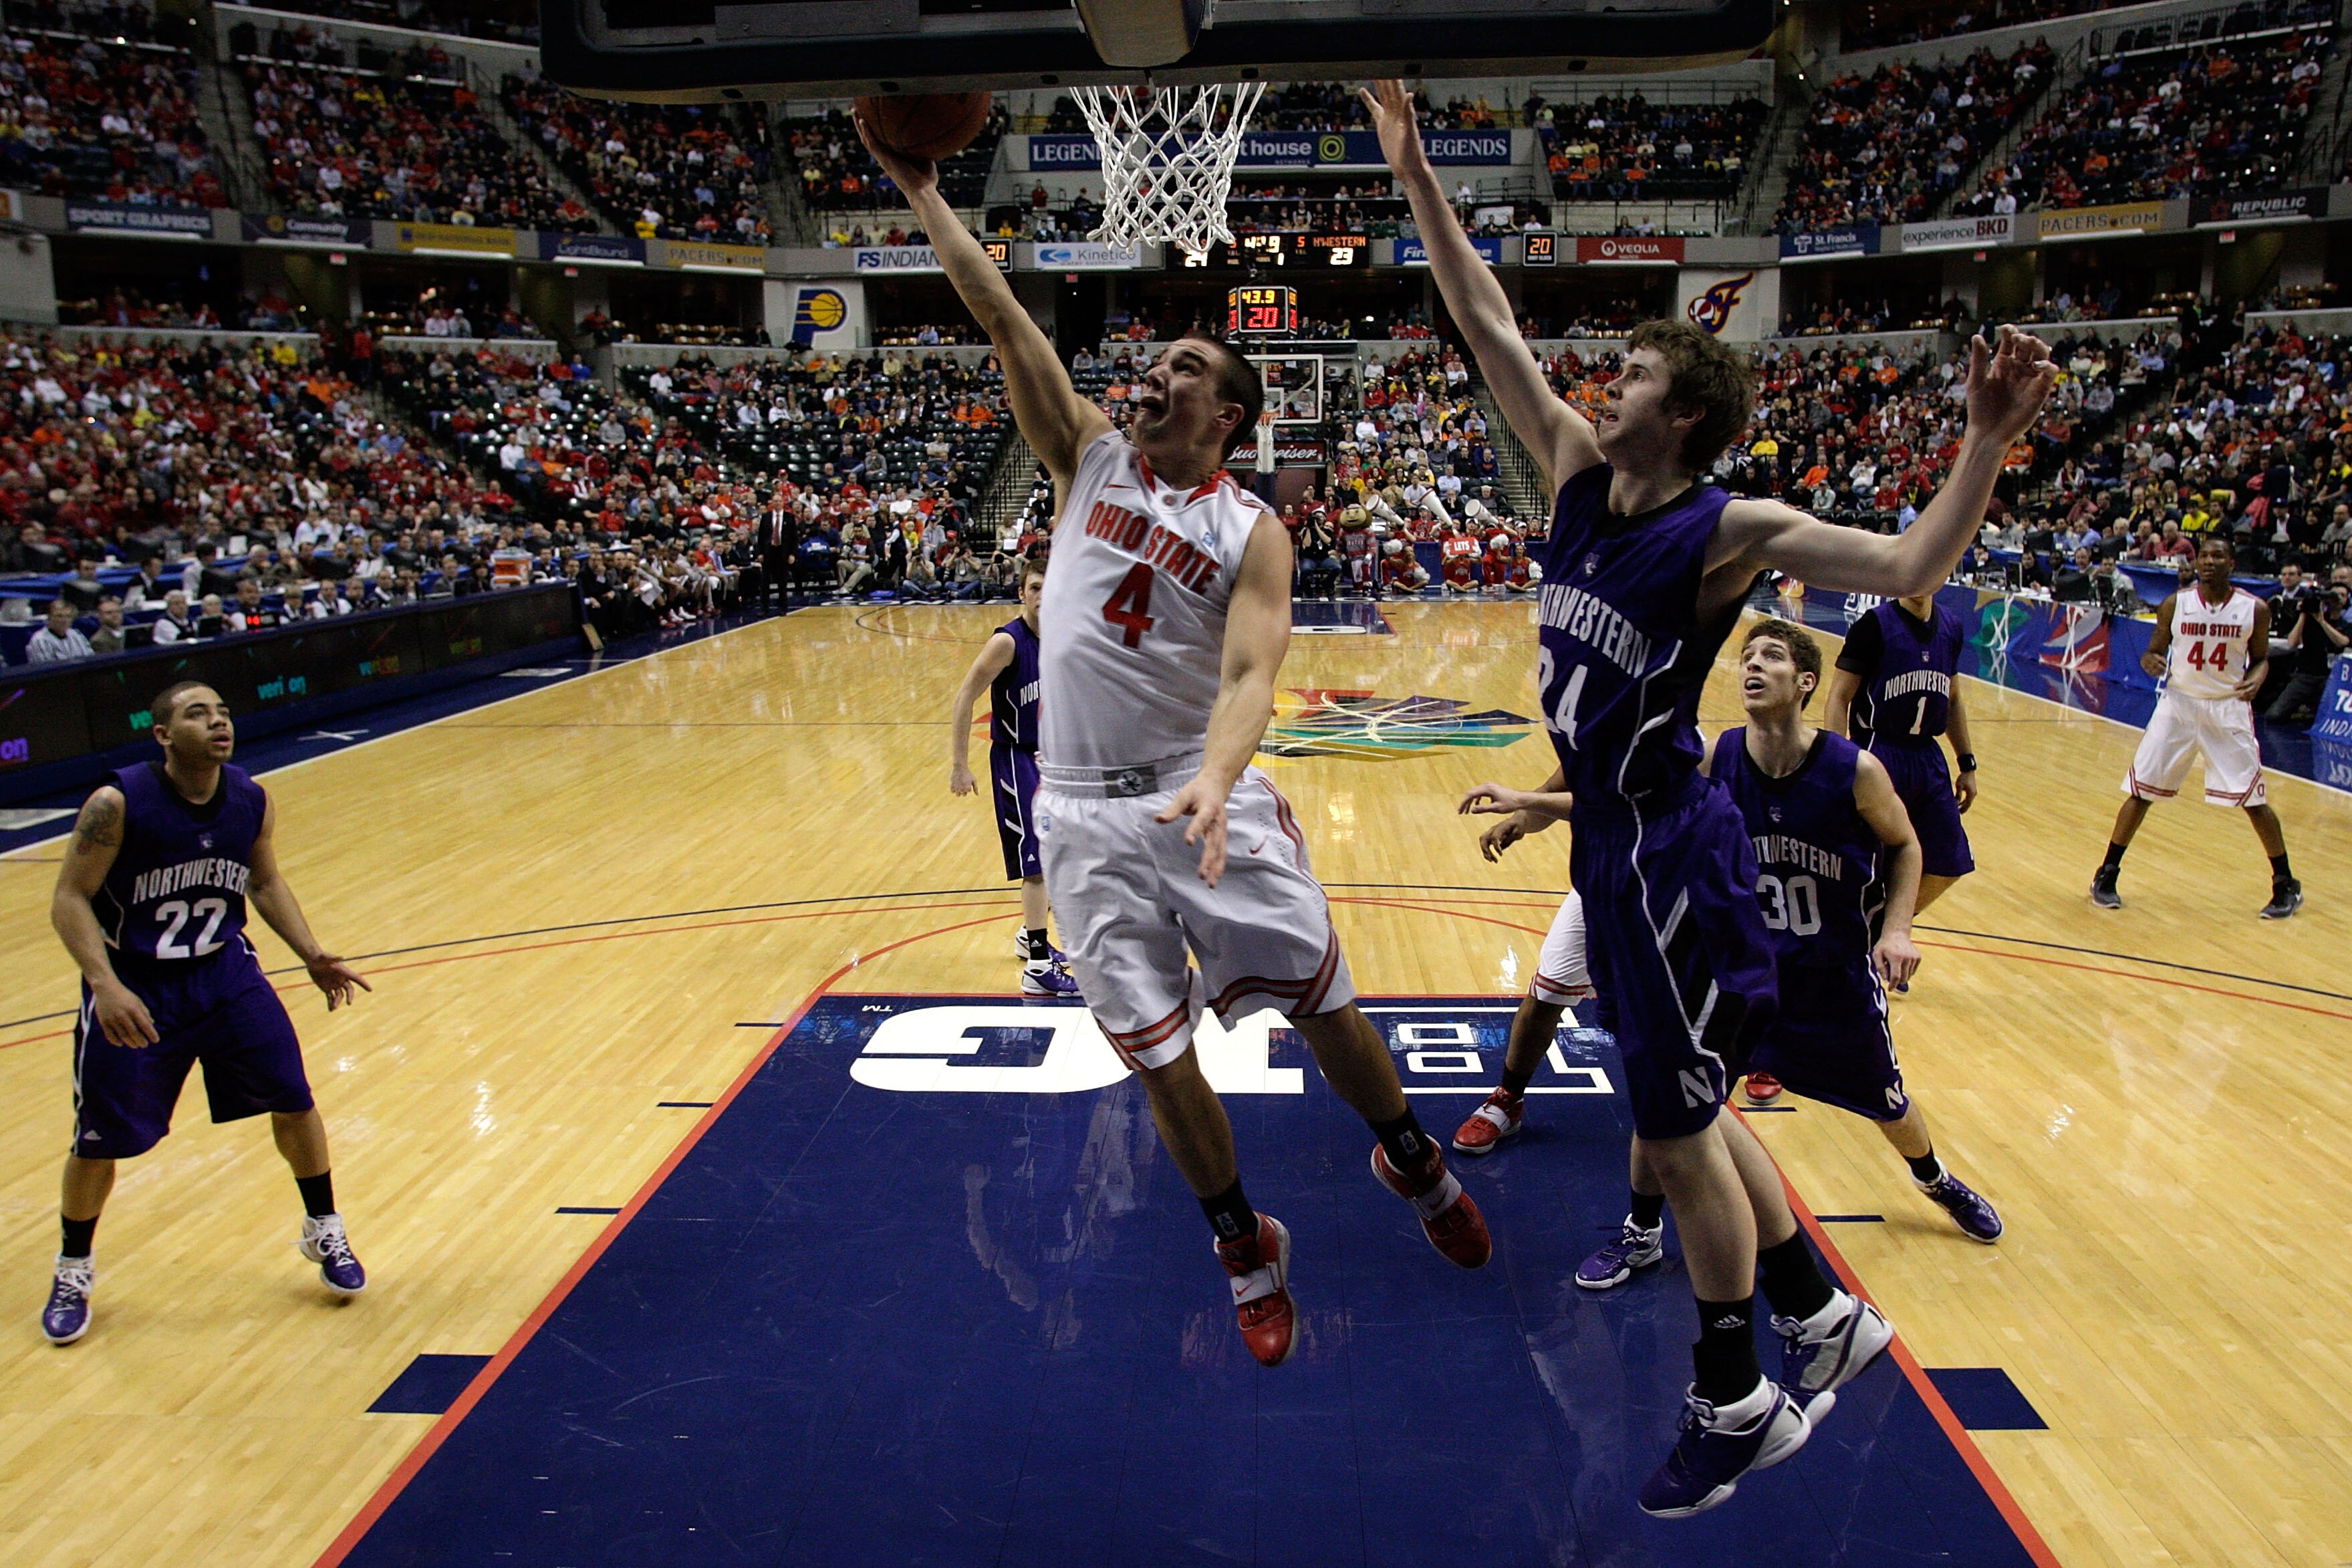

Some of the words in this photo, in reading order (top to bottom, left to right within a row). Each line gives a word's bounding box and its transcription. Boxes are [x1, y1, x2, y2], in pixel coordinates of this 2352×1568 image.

[1251, 140, 1312, 156] house
[1422, 138, 1507, 156] LEGENDS
[2231, 196, 2307, 213] REPUBLIC
[1827, 232, 1857, 244] Francis
[1903, 226, 1974, 247] experience
[1976, 219, 2008, 235] BKD
[1529, 238, 1551, 254] 20
[1617, 244, 1660, 254] VEOLIA
[858, 252, 881, 267] FS
[1078, 250, 1136, 261] Kinetico
[1330, 247, 1354, 265] 23
[1242, 290, 1275, 304] 43.9
[1247, 307, 1278, 328] 20
[1085, 500, 1149, 551] OHIO
[1144, 524, 1222, 596] STATE
[1454, 540, 1471, 551] LETS
[1101, 561, 1156, 648] 4
[2180, 622, 2206, 636] OHIO
[2209, 624, 2242, 638] STATE
[2187, 642, 2228, 671] 44
[257, 675, 306, 700] verion
[1909, 696, 1927, 735] 1
[1756, 874, 1821, 936] 30
[155, 898, 227, 959] 22
[1678, 1067, 1716, 1108] N
[1885, 1080, 1905, 1109] N
